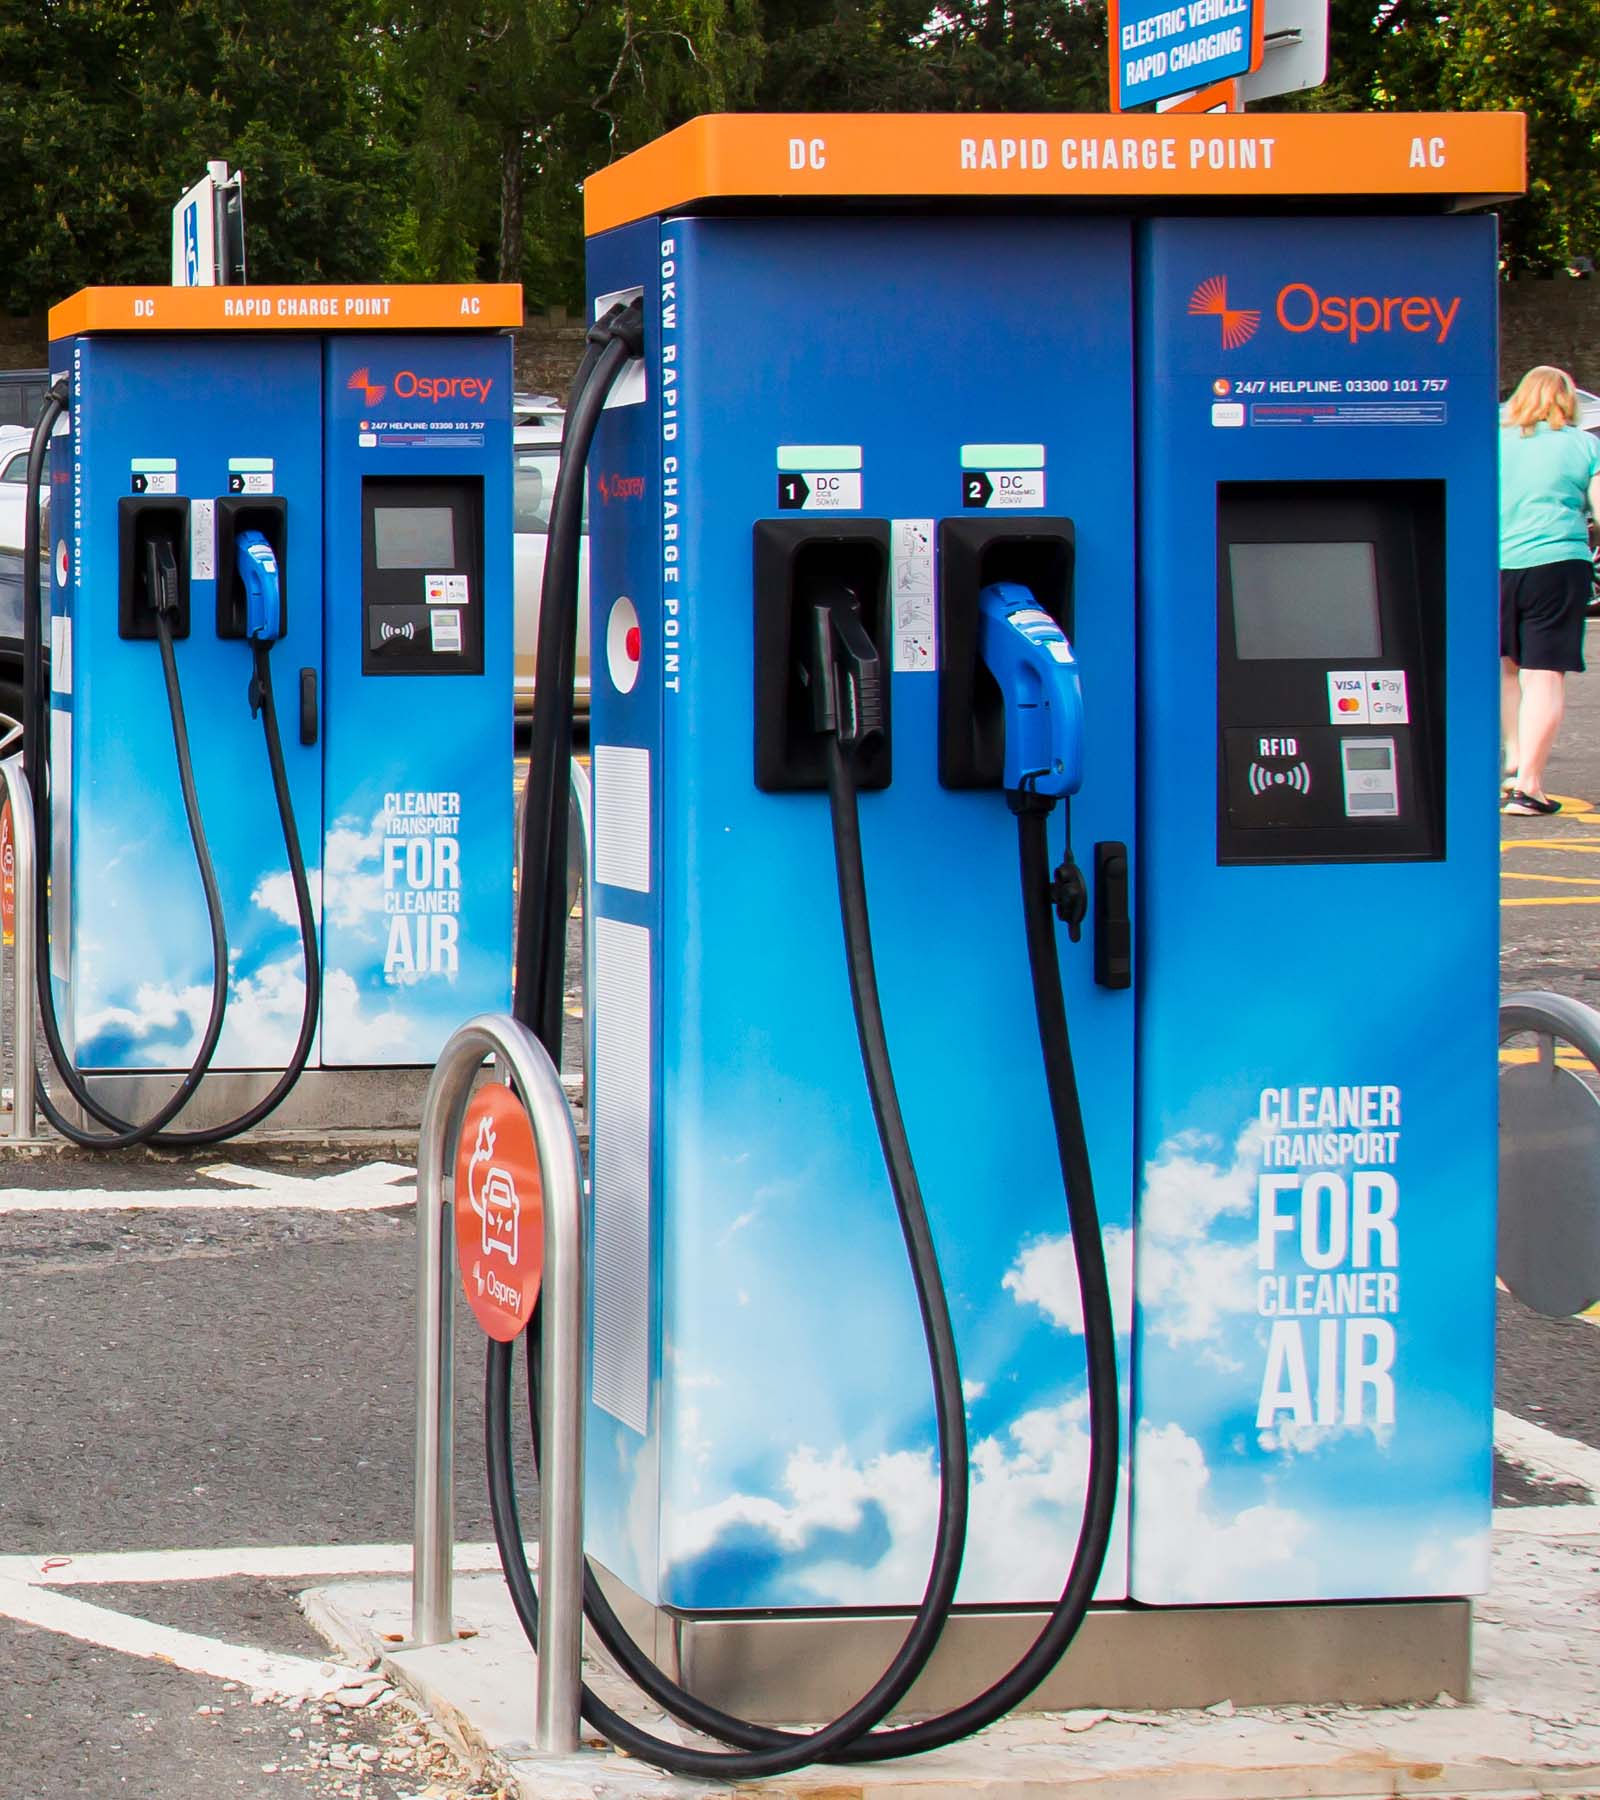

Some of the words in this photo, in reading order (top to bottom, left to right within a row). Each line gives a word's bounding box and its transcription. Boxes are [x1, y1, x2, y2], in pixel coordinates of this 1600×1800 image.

[1122, 10, 1187, 50] ELECTRIC
[1188, 0, 1248, 28] VEHICLE
[1126, 51, 1168, 86] RAPID
[1169, 26, 1243, 72] CHARGING
[788, 138, 826, 170] DC
[960, 138, 1048, 170] RAPID
[1061, 138, 1177, 170] CHARGE
[1189, 138, 1276, 169] POINT
[1408, 137, 1446, 169] AC
[661, 239, 676, 329] 50KW
[134, 299, 155, 317] DC
[224, 299, 272, 316] RAPID
[277, 298, 339, 316] CHARGE
[345, 298, 391, 315] POINT
[460, 297, 481, 314] AC
[1275, 282, 1461, 344] Osprey
[393, 370, 493, 404] Osprey
[663, 345, 678, 442] RAPID
[1235, 381, 1265, 394] 24/7
[1269, 381, 1341, 393] HELPLINE:
[1345, 380, 1388, 393] 03300
[1393, 380, 1418, 392] 101
[1422, 379, 1448, 392] 757
[135, 479, 142, 488] 1
[232, 479, 240, 488] 2
[785, 483, 795, 500] 1
[816, 477, 840, 490] DC
[969, 481, 982, 498] 2
[1000, 476, 1023, 489] DC
[663, 456, 679, 583] CHARGE
[74, 538, 82, 588] POINT
[664, 599, 680, 694] POINT
[1335, 680, 1362, 691] VISA
[1382, 680, 1401, 693] Pay
[1385, 703, 1403, 714] Pay
[1259, 738, 1298, 756] RFID
[384, 792, 460, 815] CLEANER
[385, 817, 460, 835] TRANSPORT
[384, 837, 460, 890] FOR
[384, 891, 460, 914] CLEANER
[383, 914, 459, 973] AIR
[1259, 1085, 1399, 1129] CLEANER
[1263, 1132, 1400, 1166] TRANSPORT
[1258, 1170, 1399, 1270] FOR
[487, 1270, 522, 1315] Osprey
[1257, 1272, 1399, 1316] CLEANER
[1255, 1318, 1397, 1429] AIR
